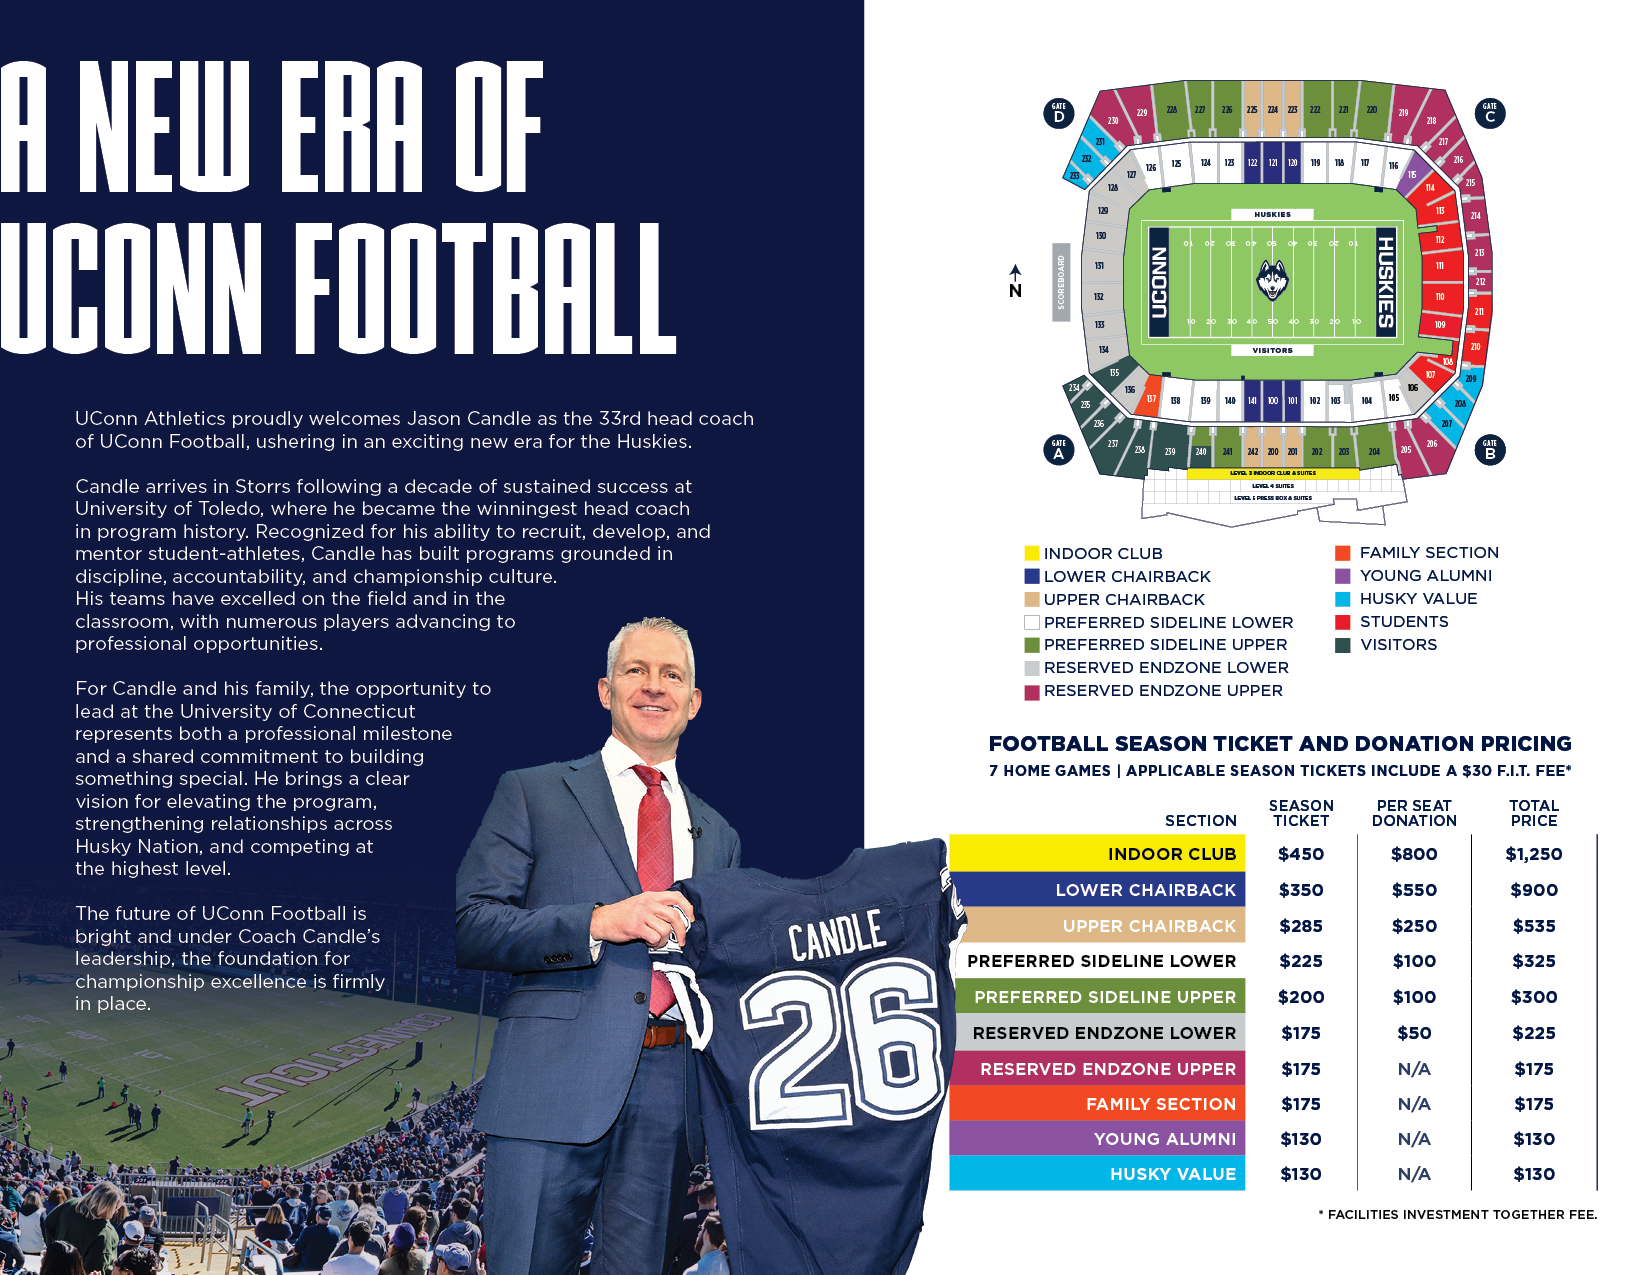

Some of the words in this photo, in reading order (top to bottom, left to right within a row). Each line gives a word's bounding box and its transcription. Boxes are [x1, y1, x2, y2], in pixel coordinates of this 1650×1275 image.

[1055, 111, 1064, 122] D
[1486, 111, 1495, 122] C
[1, 61, 46, 192] A
[80, 61, 249, 192] NEW
[282, 61, 422, 192] ERA
[456, 61, 543, 192] OF
[1, 223, 261, 354] UCONN
[296, 223, 676, 354] FOOTBALL
[1057, 254, 1066, 310] SCOREBOARD
[1151, 246, 1168, 319] UCONN
[1378, 236, 1394, 329] HUSKIES
[1010, 284, 1021, 297] N
[1465, 374, 1478, 384] 209
[76, 411, 137, 425] UConn
[144, 411, 225, 425] Athletics
[233, 411, 303, 428] proudly
[309, 411, 400, 425] welcomes
[407, 411, 460, 425] Jason
[468, 411, 531, 425] Candle
[538, 415, 557, 425] as
[564, 411, 592, 425] the
[600, 411, 640, 425] 33rd
[648, 411, 692, 425] head
[699, 411, 753, 425] coach
[1053, 449, 1064, 459] A
[1486, 449, 1495, 459] B
[1045, 548, 1112, 559] INDOOR
[1118, 548, 1162, 559] CLUB
[1361, 547, 1420, 558] FAMILY
[1426, 547, 1498, 558] SECTION
[1045, 571, 1106, 582] LOWER
[1112, 571, 1211, 582] CHAIRBACK
[1360, 570, 1421, 581] YOUNG
[1427, 570, 1491, 581] ALUMNI
[1361, 616, 1448, 627] STUDENTS
[1361, 639, 1437, 650] VISITORS
[990, 736, 1108, 751] FOOTBALL
[1115, 736, 1206, 751] SEASON
[1213, 736, 1293, 751] TICKET
[1299, 736, 1348, 751] AND
[1356, 736, 1473, 751] DONATION
[1482, 736, 1571, 751] PRICING
[1166, 815, 1236, 826] SECTION
[1109, 848, 1183, 860] INDOOR
[1189, 848, 1236, 860] CLUB
[1278, 846, 1324, 862] $450
[1391, 846, 1437, 862] $800
[1506, 846, 1562, 863] $1,250
[1057, 884, 1122, 896] LOWER
[1129, 884, 1236, 896] CHAIRBACK
[1279, 882, 1323, 898] $350
[1392, 882, 1437, 898] $550
[1511, 882, 1558, 898] $900
[76, 906, 109, 920] The
[116, 906, 170, 920] future
[177, 906, 196, 920] of
[203, 906, 263, 920] UConn
[272, 906, 345, 920] Football
[354, 906, 366, 920] is
[1064, 920, 1122, 932] UPPER
[1130, 920, 1236, 932] CHAIRBACK
[1280, 918, 1322, 934] $285
[1392, 918, 1437, 934] $250
[1513, 918, 1555, 934] $535
[789, 910, 887, 961] CANDLE
[740, 957, 944, 1130] 26
[1111, 1168, 1171, 1180] HUSKY
[1177, 1168, 1236, 1180] VALUE
[1281, 1166, 1321, 1182] $130
[1399, 1166, 1431, 1183] N/A
[1514, 1166, 1555, 1182] $130
[1329, 1210, 1398, 1219] FACILITIES
[1404, 1210, 1489, 1219] INVESTMENT
[1493, 1210, 1564, 1219] TOGETHER
[1570, 1210, 1597, 1219] FEE.
